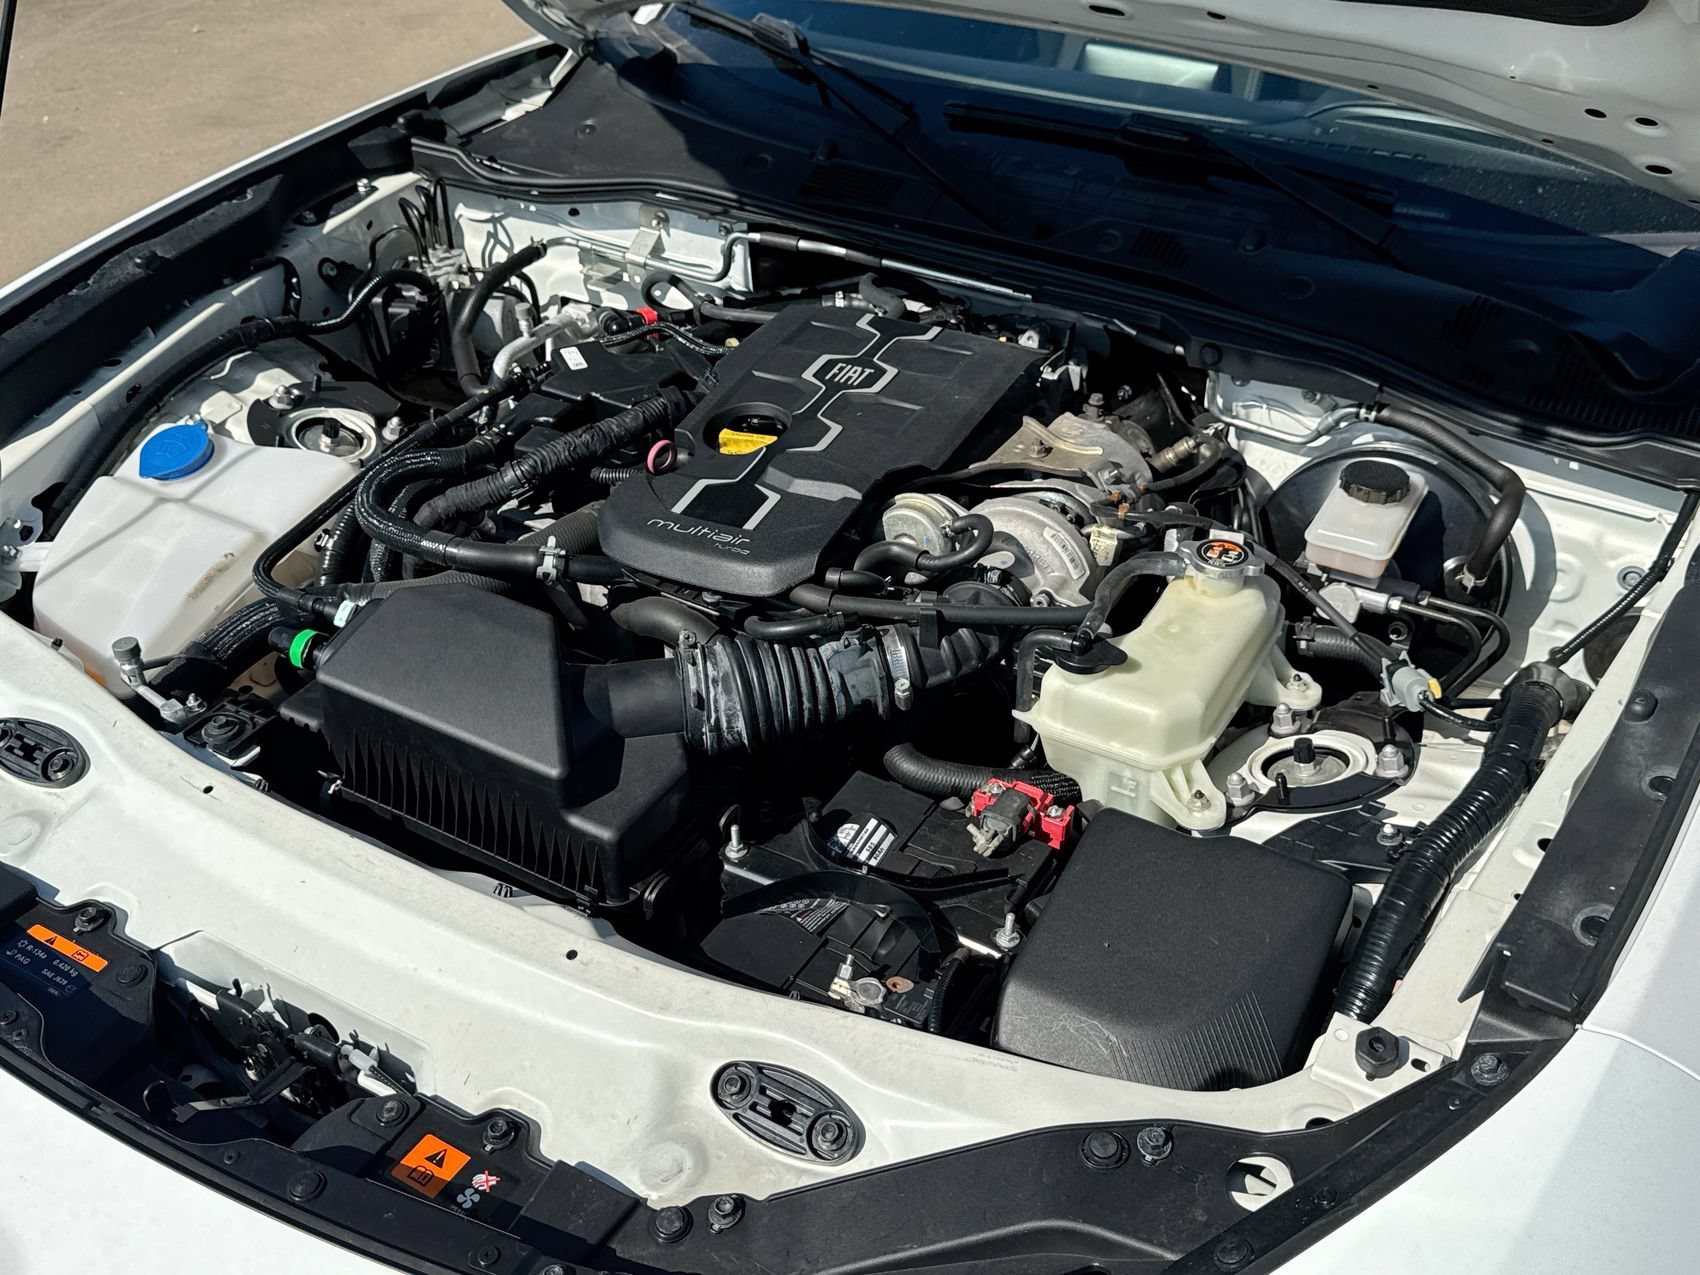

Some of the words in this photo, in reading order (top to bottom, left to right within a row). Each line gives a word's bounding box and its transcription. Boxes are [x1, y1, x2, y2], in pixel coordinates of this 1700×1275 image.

[825, 362, 875, 386] FIAT
[647, 518, 750, 545] multiair
[14, 953, 31, 965] PAG
[41, 968, 55, 979] SAE
